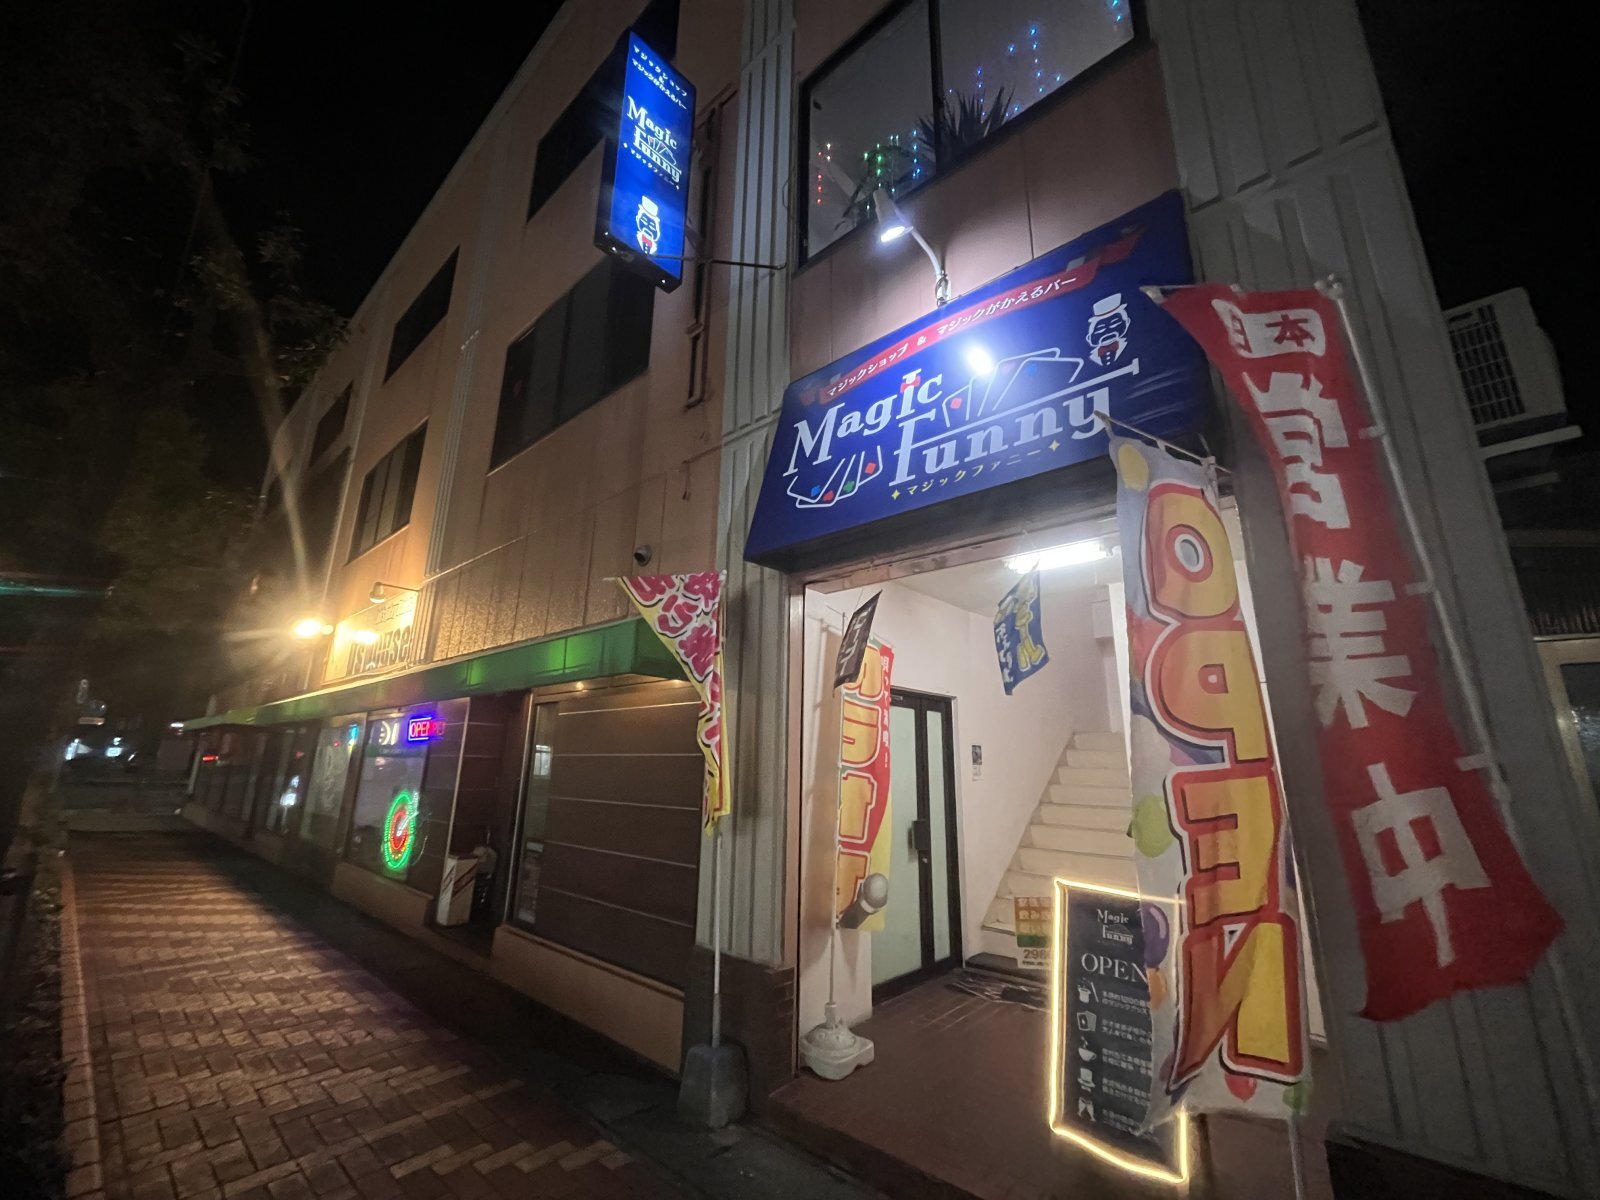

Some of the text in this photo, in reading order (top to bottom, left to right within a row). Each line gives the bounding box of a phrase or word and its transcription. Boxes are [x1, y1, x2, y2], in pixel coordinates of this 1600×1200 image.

[626, 95, 678, 150] Magic
[633, 125, 682, 182] Funny
[827, 277, 1077, 397] マジックショップ & マジックがかえるバー
[783, 368, 943, 477] Magic
[889, 358, 1140, 487] Funny
[907, 449, 1041, 495] マジックファニー
[1096, 909, 1130, 924] Magic
[1102, 925, 1134, 946] Funny
